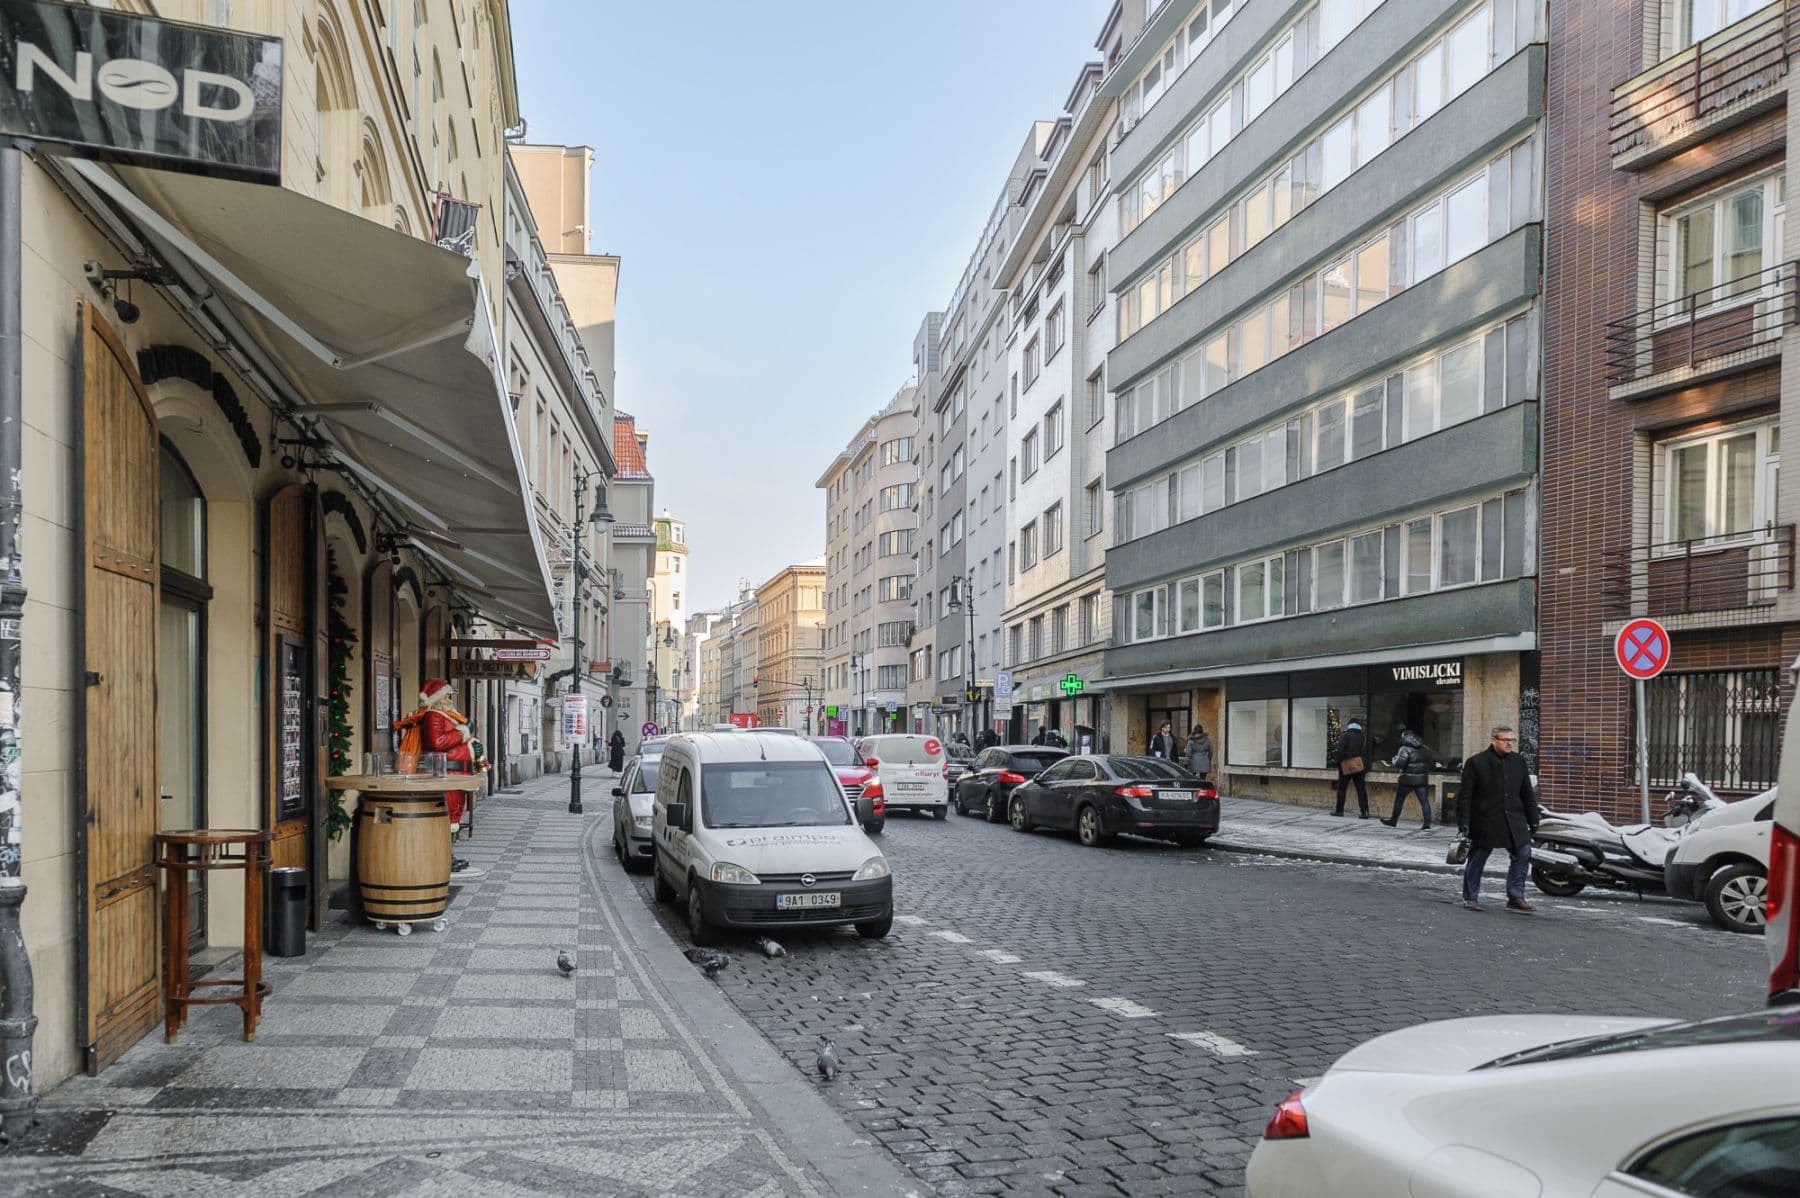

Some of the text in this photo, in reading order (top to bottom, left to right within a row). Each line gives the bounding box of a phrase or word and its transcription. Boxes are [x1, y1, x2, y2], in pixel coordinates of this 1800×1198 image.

[16, 40, 255, 122] NOD
[1392, 662, 1461, 681] VIMISLICKI
[785, 894, 836, 906] 9A1 0349
